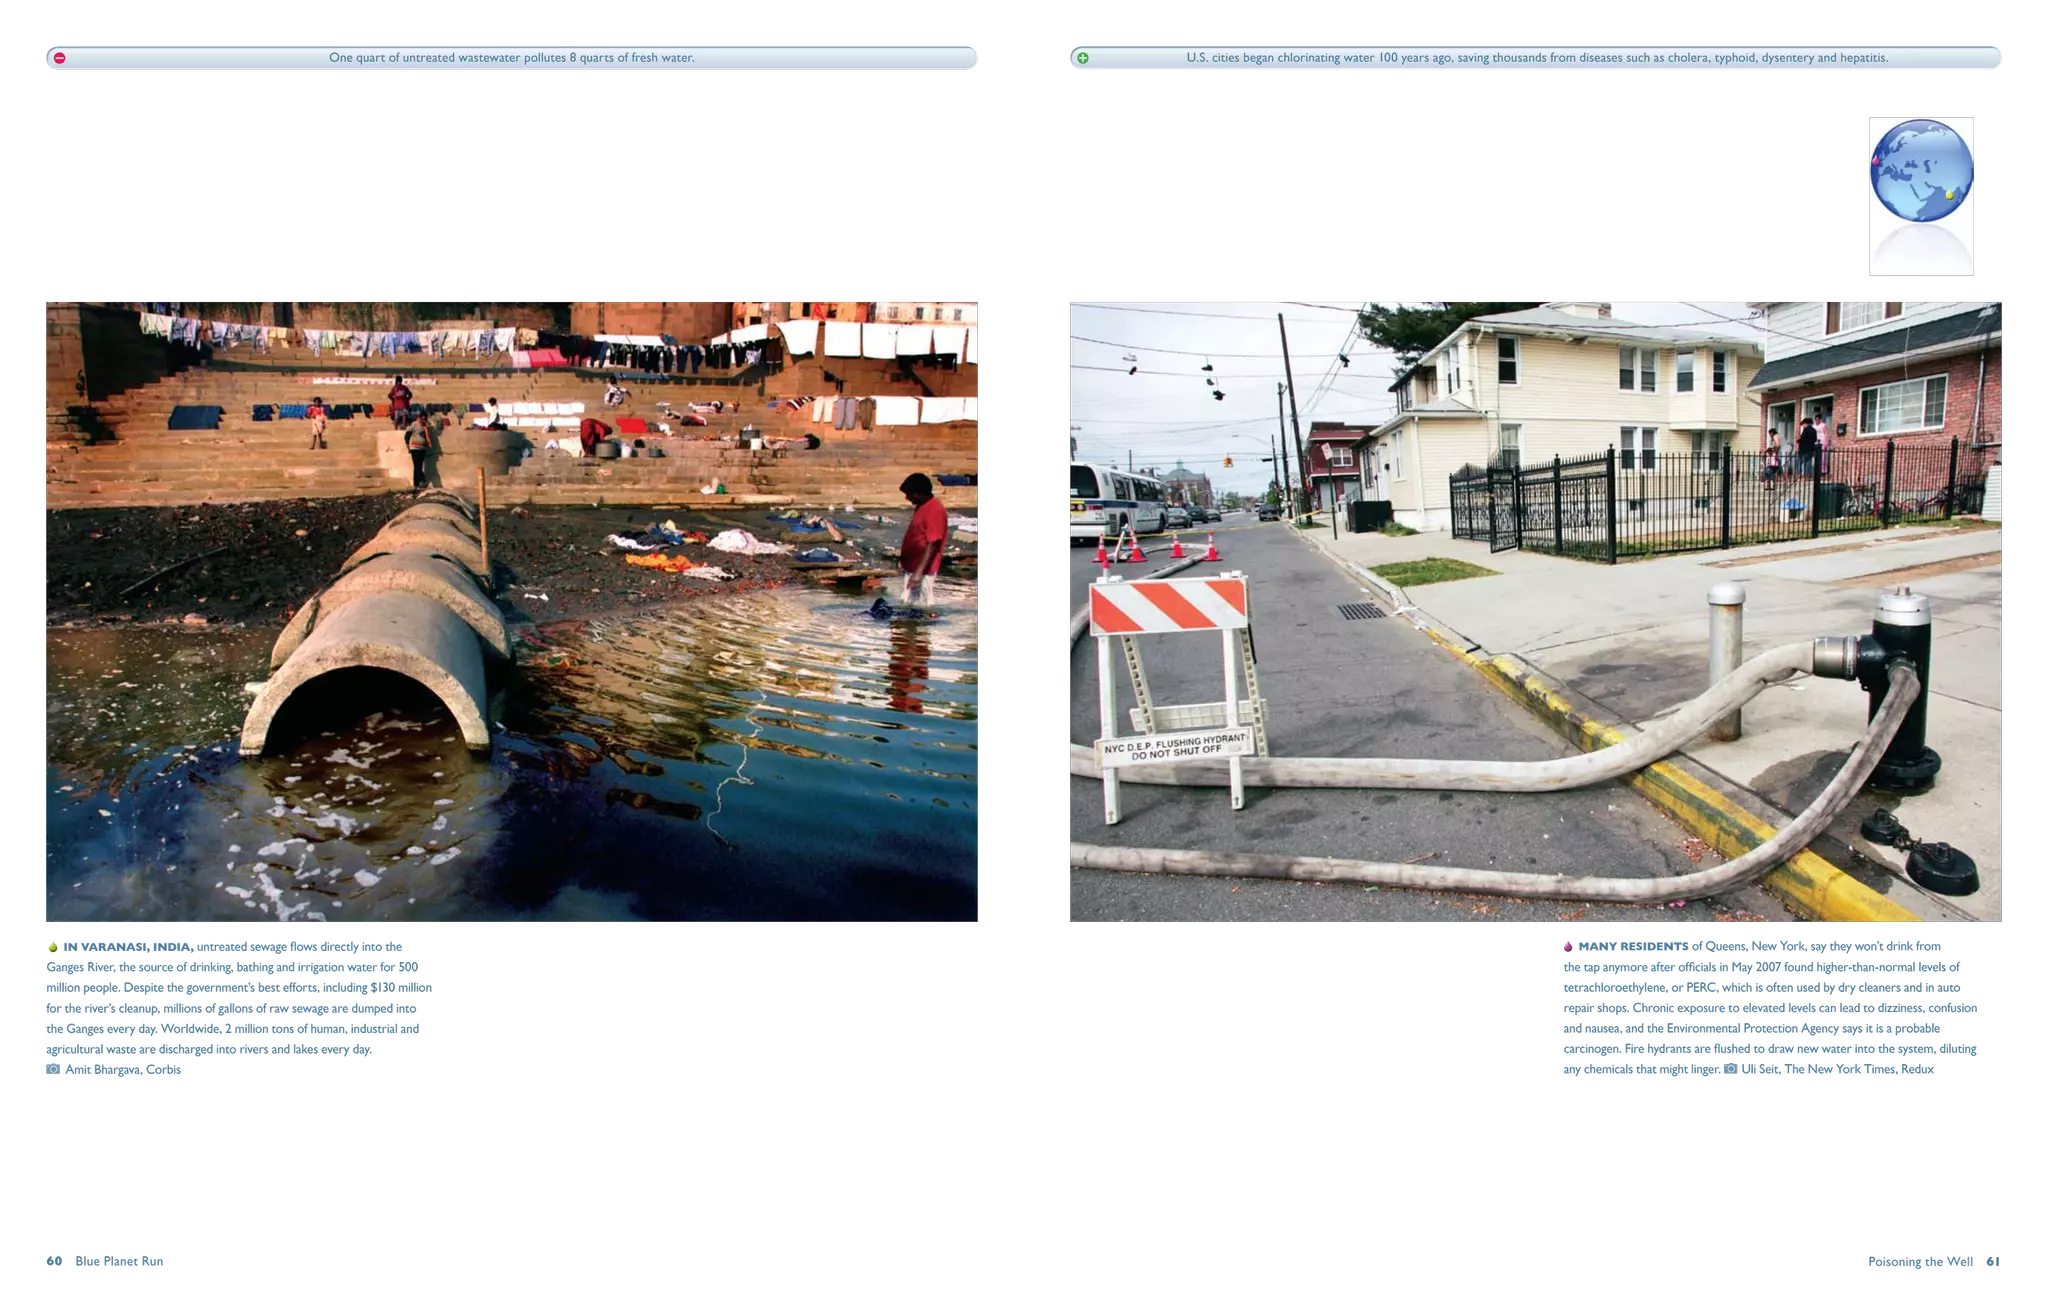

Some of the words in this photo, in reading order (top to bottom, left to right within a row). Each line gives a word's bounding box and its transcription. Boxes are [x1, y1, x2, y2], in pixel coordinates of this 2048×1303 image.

[1105, 745, 1125, 753] NYC
[1128, 742, 1154, 752] D.E.P.
[1156, 737, 1201, 748] FLUSHING
[1203, 733, 1246, 744] HYDRANT
[1132, 752, 1147, 761] DO
[1150, 749, 1170, 759] NOT
[1173, 747, 1199, 757] SHUT
[1202, 744, 1222, 754] OFF
